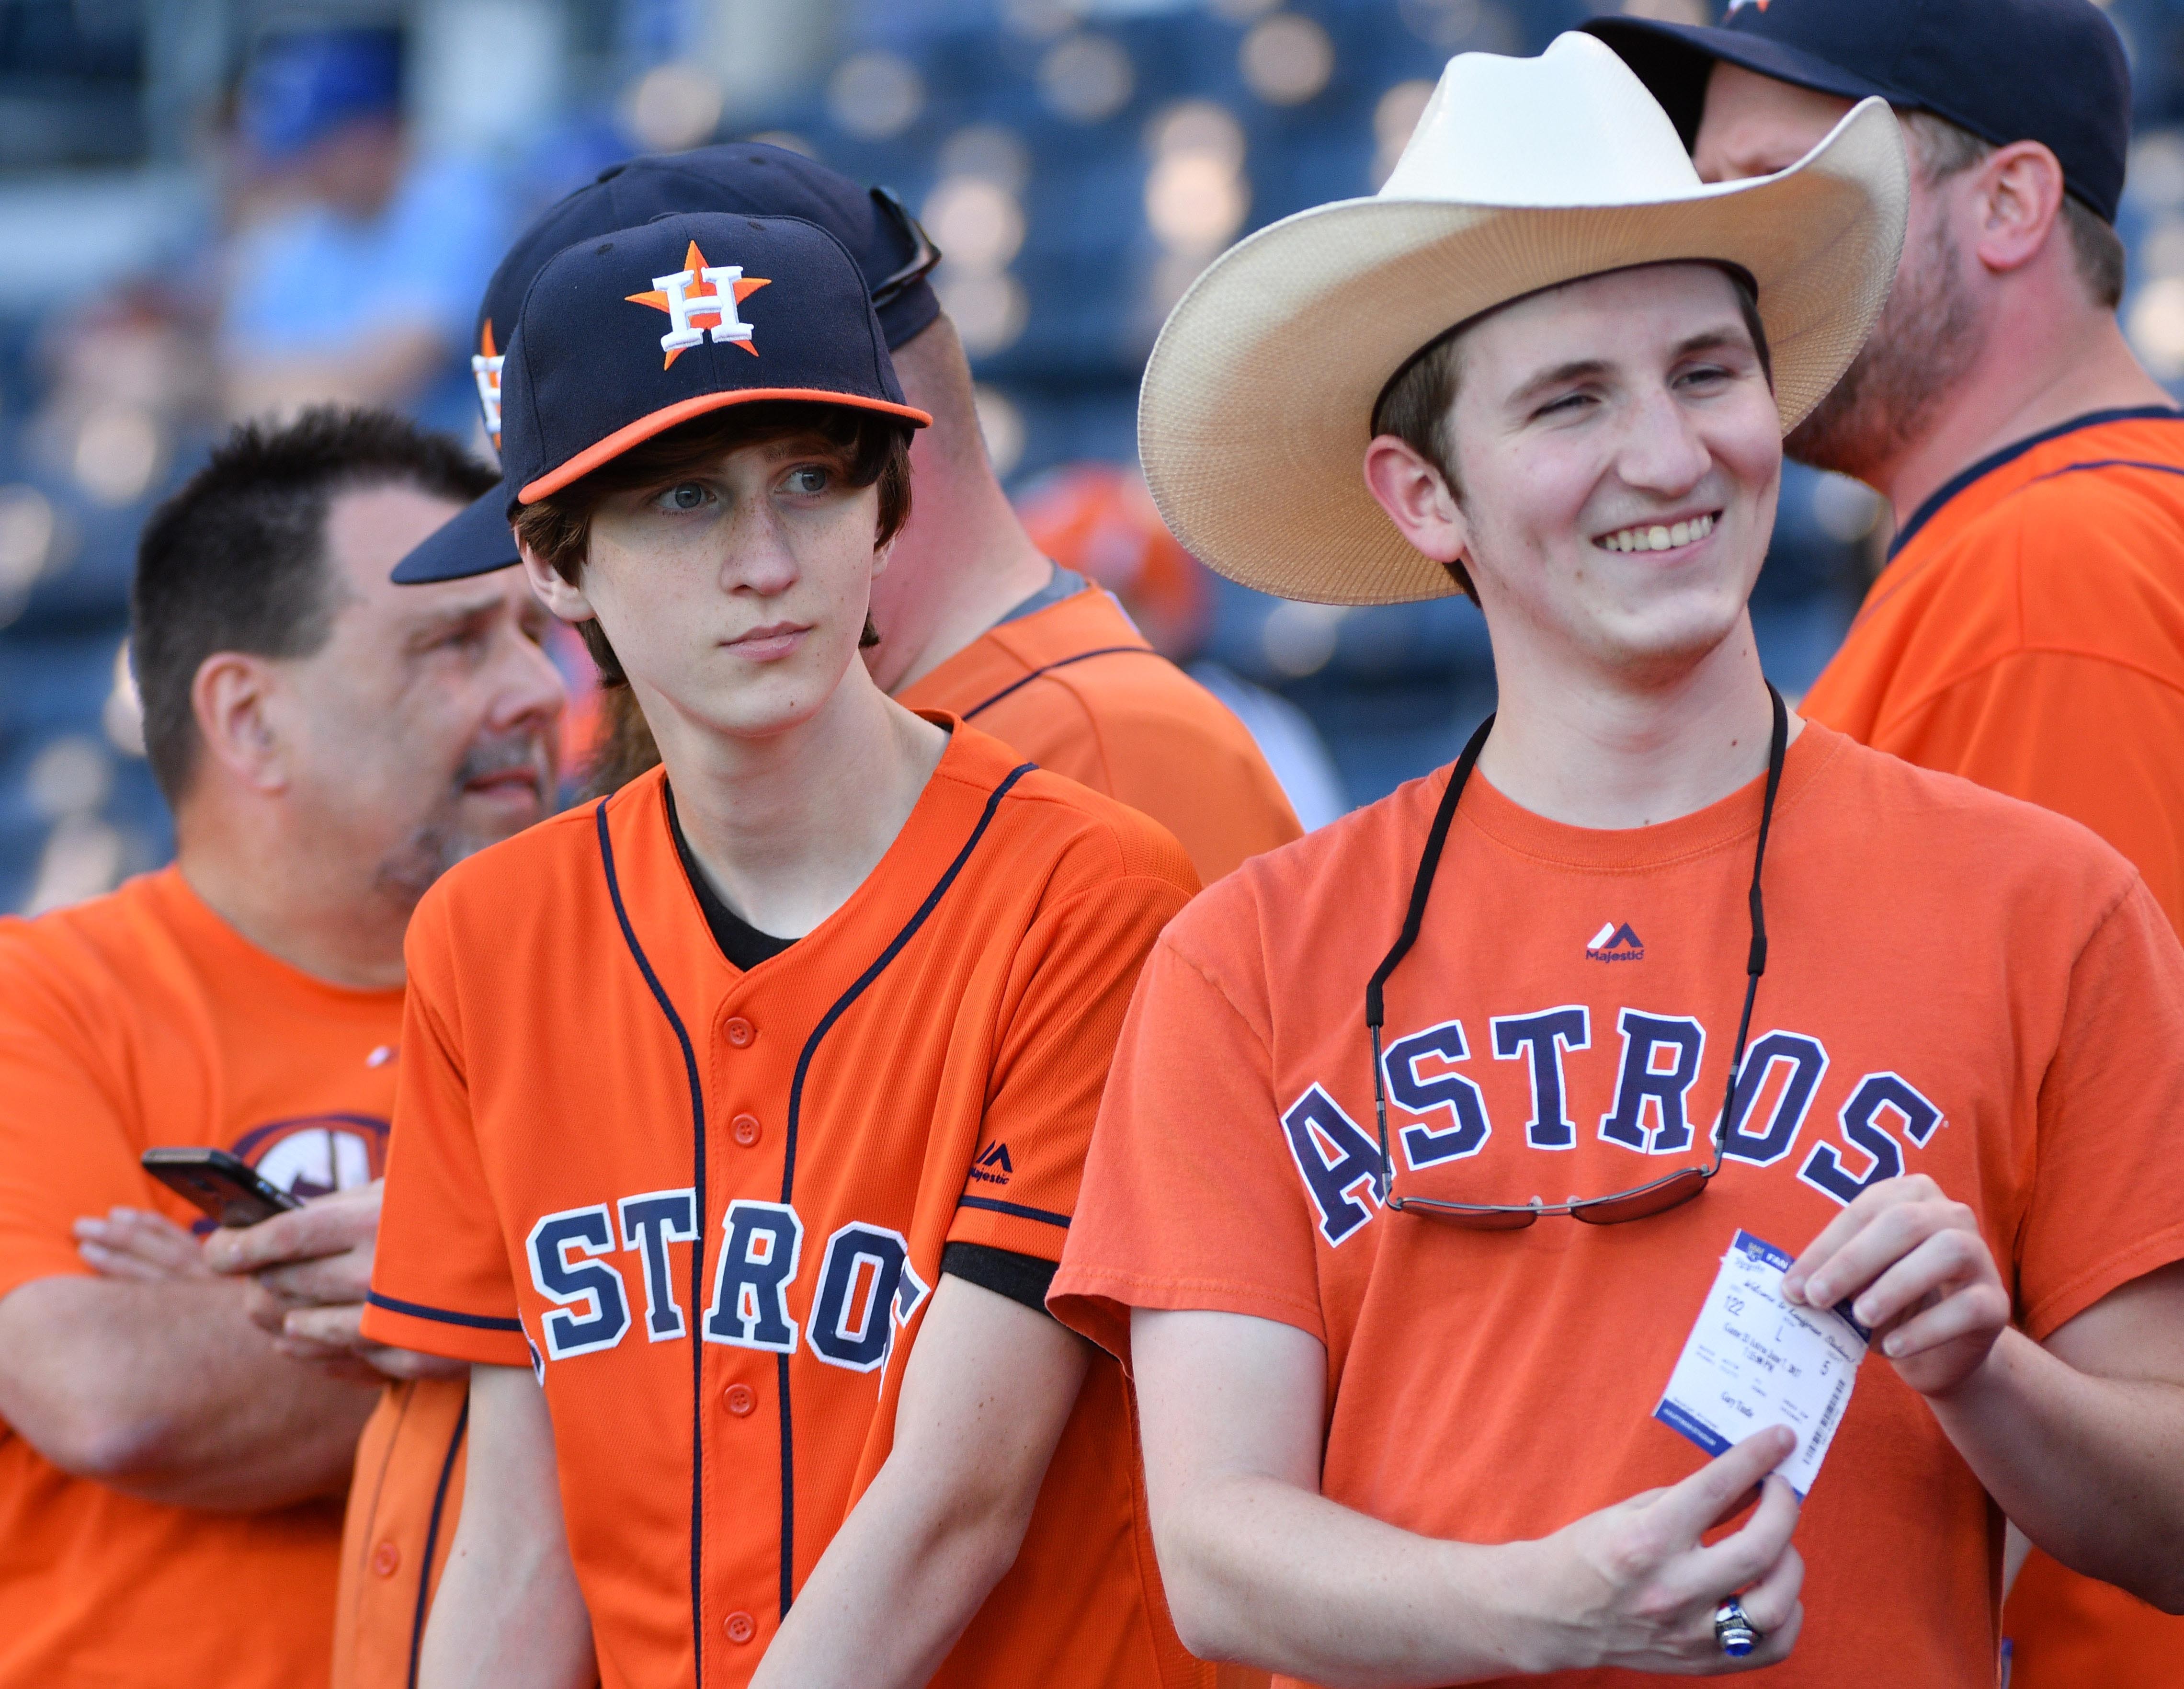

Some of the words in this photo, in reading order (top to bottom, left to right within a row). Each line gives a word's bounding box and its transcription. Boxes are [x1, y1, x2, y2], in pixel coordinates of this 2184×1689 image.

[652, 266, 754, 352] H
[1585, 950, 1644, 963] Majestic
[1281, 1004, 1945, 1248] ASTROS
[519, 1187, 930, 1401] STRO
[1724, 1295, 1745, 1316] 122
